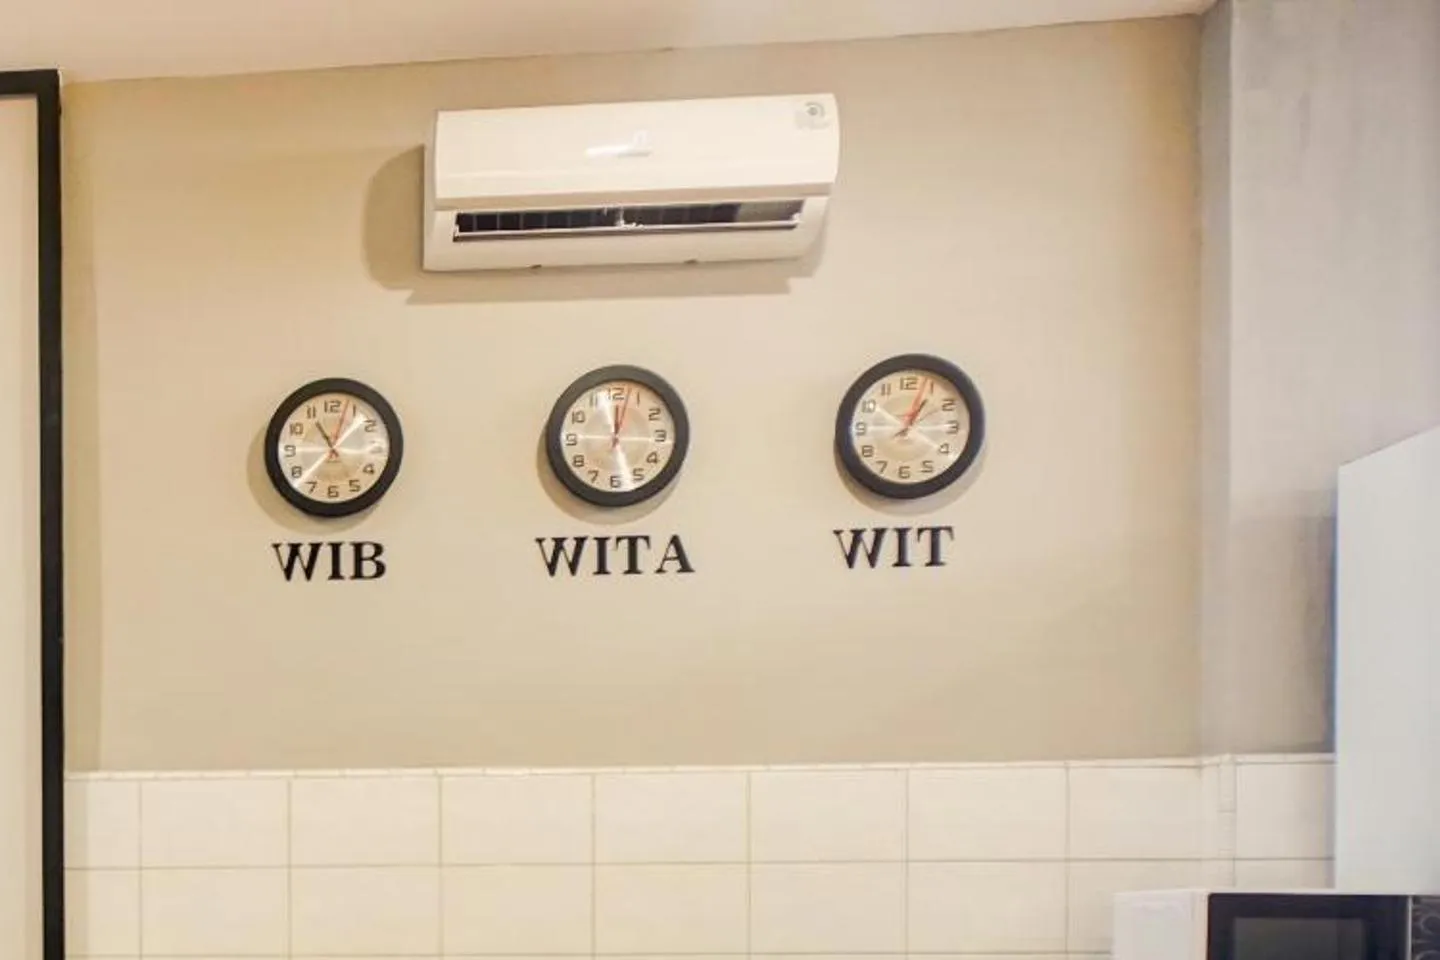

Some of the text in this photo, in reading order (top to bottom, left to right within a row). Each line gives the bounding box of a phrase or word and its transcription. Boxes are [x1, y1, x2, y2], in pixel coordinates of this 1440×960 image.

[881, 383, 891, 396] 11
[900, 377, 918, 390] 12
[324, 400, 341, 413] 12
[942, 399, 955, 411] 2
[307, 406, 316, 419] 11
[572, 411, 585, 424] 10
[648, 408, 660, 421] 2
[290, 423, 304, 436] 10
[364, 420, 377, 432] 2
[855, 422, 866, 435] 9
[946, 420, 958, 434] 3
[654, 430, 666, 442] 3
[284, 445, 296, 457] 9
[572, 455, 585, 467] 8
[646, 452, 658, 464] 4
[291, 466, 302, 478] 8
[363, 464, 374, 474] 4
[876, 461, 888, 473] 7
[898, 466, 910, 479] 6
[921, 460, 934, 472] 5
[588, 470, 599, 483] 7
[633, 468, 644, 481] 5
[305, 482, 317, 493] 7
[327, 486, 339, 498] 6
[349, 480, 360, 492] 5
[833, 526, 954, 569] WIT
[271, 541, 387, 582] WIB
[535, 534, 695, 577] WITA
